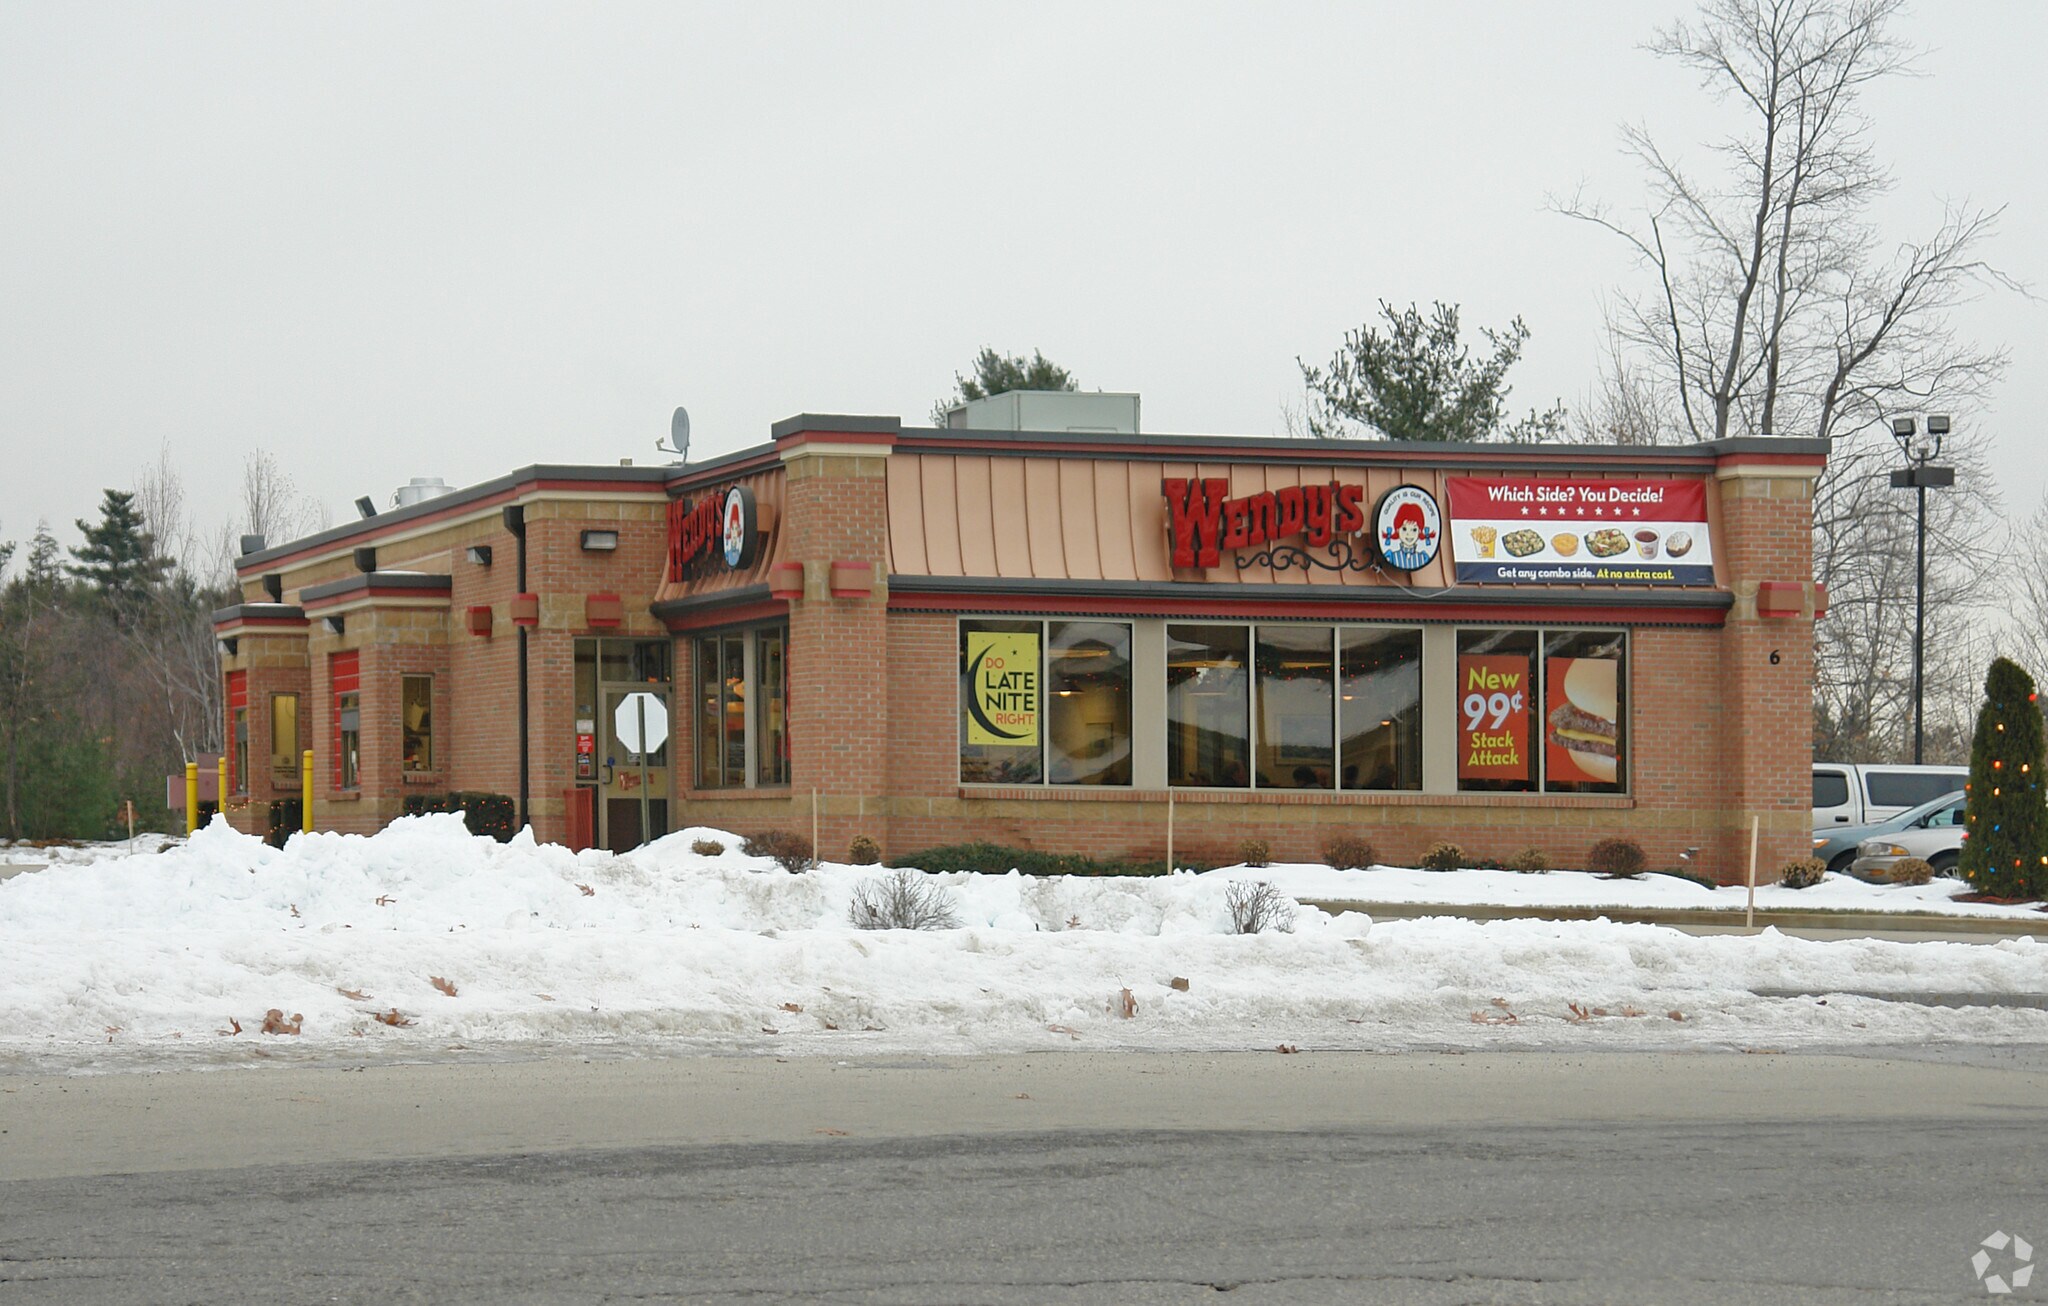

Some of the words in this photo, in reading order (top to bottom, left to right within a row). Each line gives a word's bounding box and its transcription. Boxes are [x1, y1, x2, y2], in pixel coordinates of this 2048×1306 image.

[1488, 486, 1534, 502] Which
[1537, 486, 1575, 502] Side?
[1579, 487, 1606, 503] You
[1609, 487, 1664, 503] Decide!
[1164, 478, 1363, 568] Wendy's
[1497, 567, 1516, 578] Get
[1518, 569, 1537, 580] any
[1538, 568, 1571, 579] combo
[1573, 568, 1595, 579] side.
[1597, 569, 1608, 579] At
[1610, 571, 1622, 579] no
[1623, 570, 1650, 580] extra
[1652, 570, 1675, 580] cost.
[985, 657, 1005, 669] DO
[1770, 650, 1780, 665] 6
[985, 671, 1035, 690] LATE
[1468, 666, 1520, 690] New
[985, 692, 1035, 711] NITE
[1463, 690, 1523, 731] 99¢
[1471, 730, 1514, 748] Stack
[1467, 748, 1519, 766] Attack
